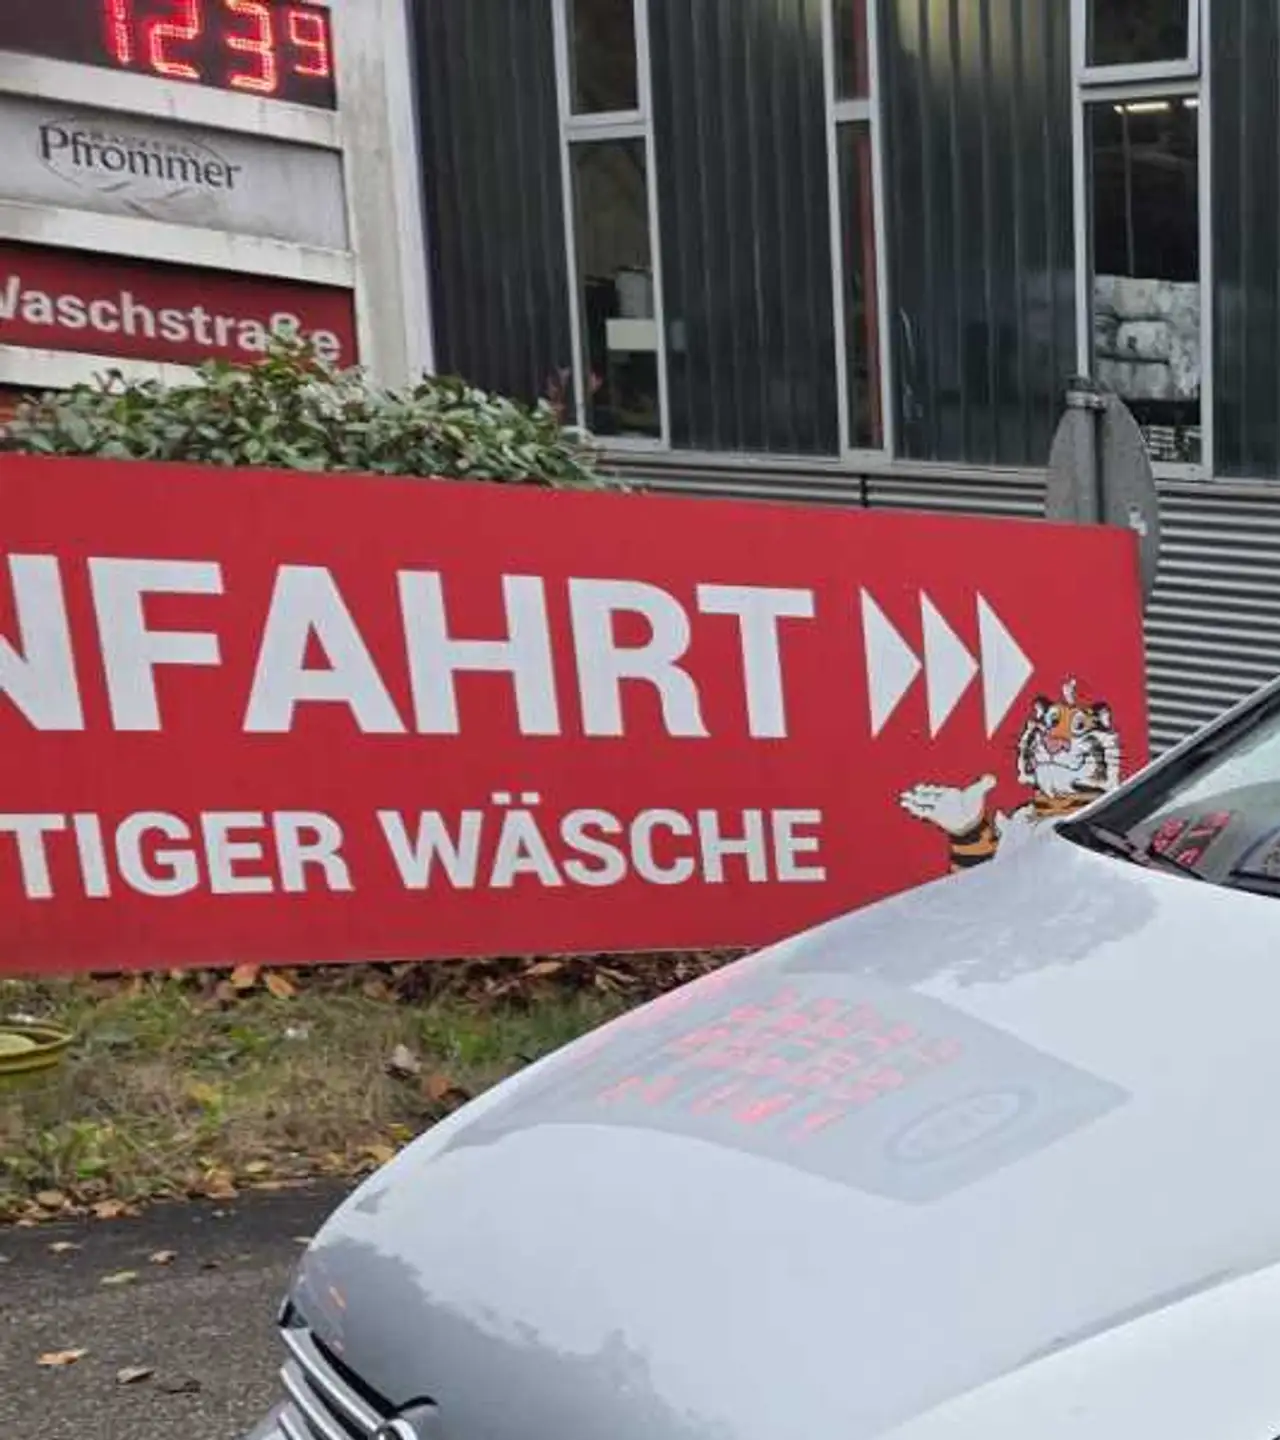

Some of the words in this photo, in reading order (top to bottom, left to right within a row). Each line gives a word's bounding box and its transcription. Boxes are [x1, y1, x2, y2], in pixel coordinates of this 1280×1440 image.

[38, 124, 242, 190] Pfrommer
[0, 811, 354, 900] TIGER
[376, 792, 828, 889] WÄSCHE
